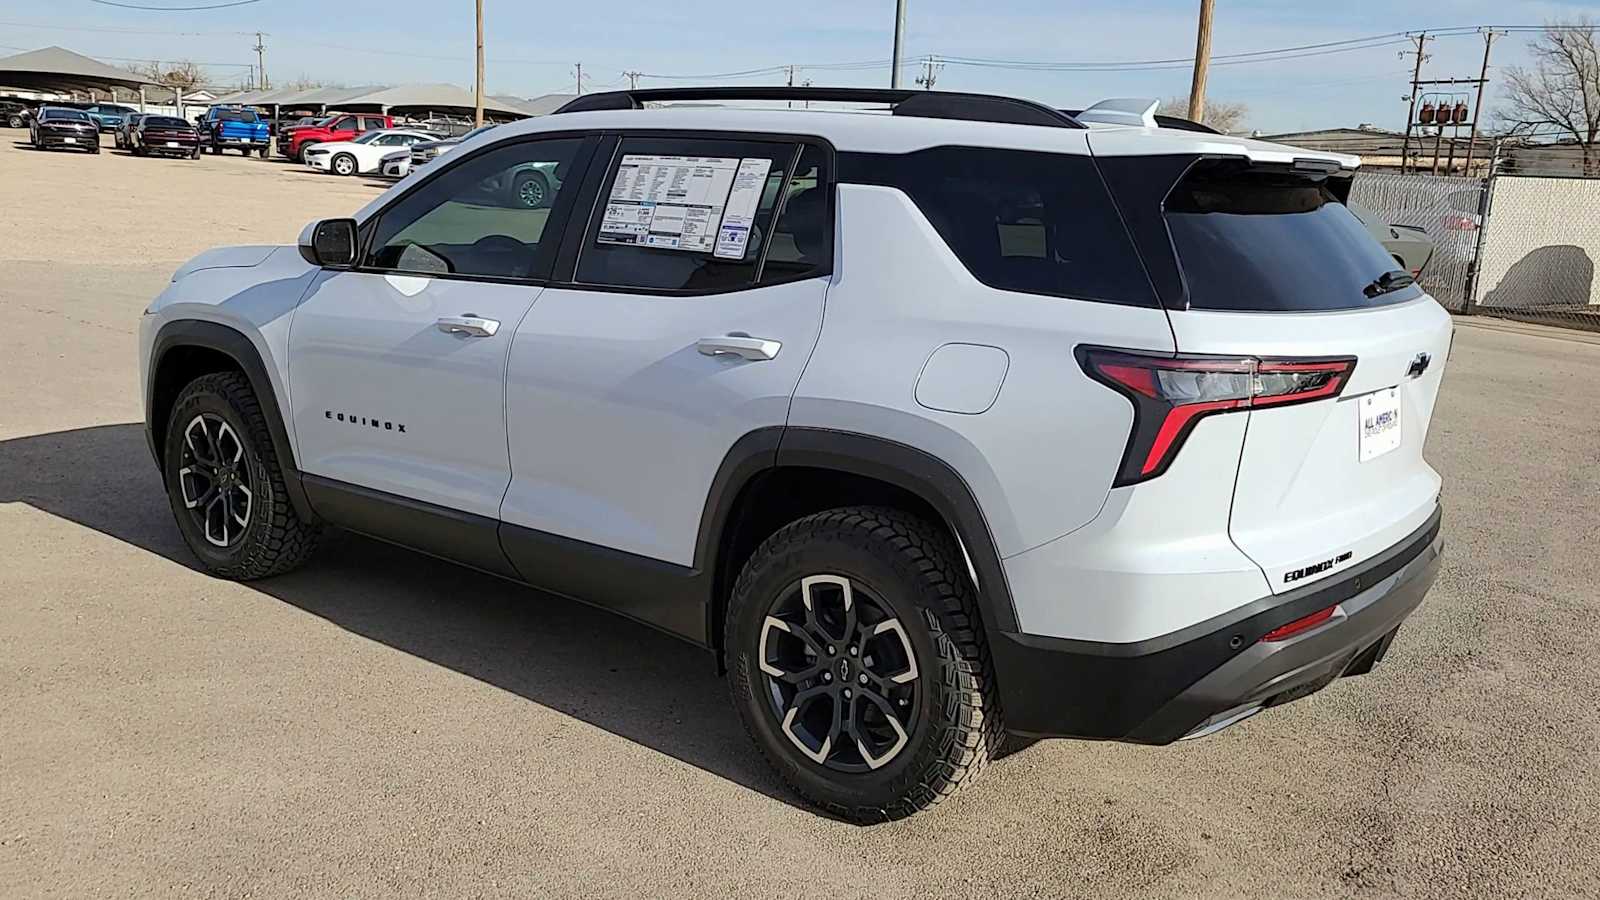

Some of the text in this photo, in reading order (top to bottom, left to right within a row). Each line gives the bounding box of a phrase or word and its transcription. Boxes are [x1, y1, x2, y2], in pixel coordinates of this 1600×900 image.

[325, 410, 406, 433] EQUINOX
[1375, 407, 1398, 426] AMERICN
[1284, 558, 1334, 583] EQUINOX
